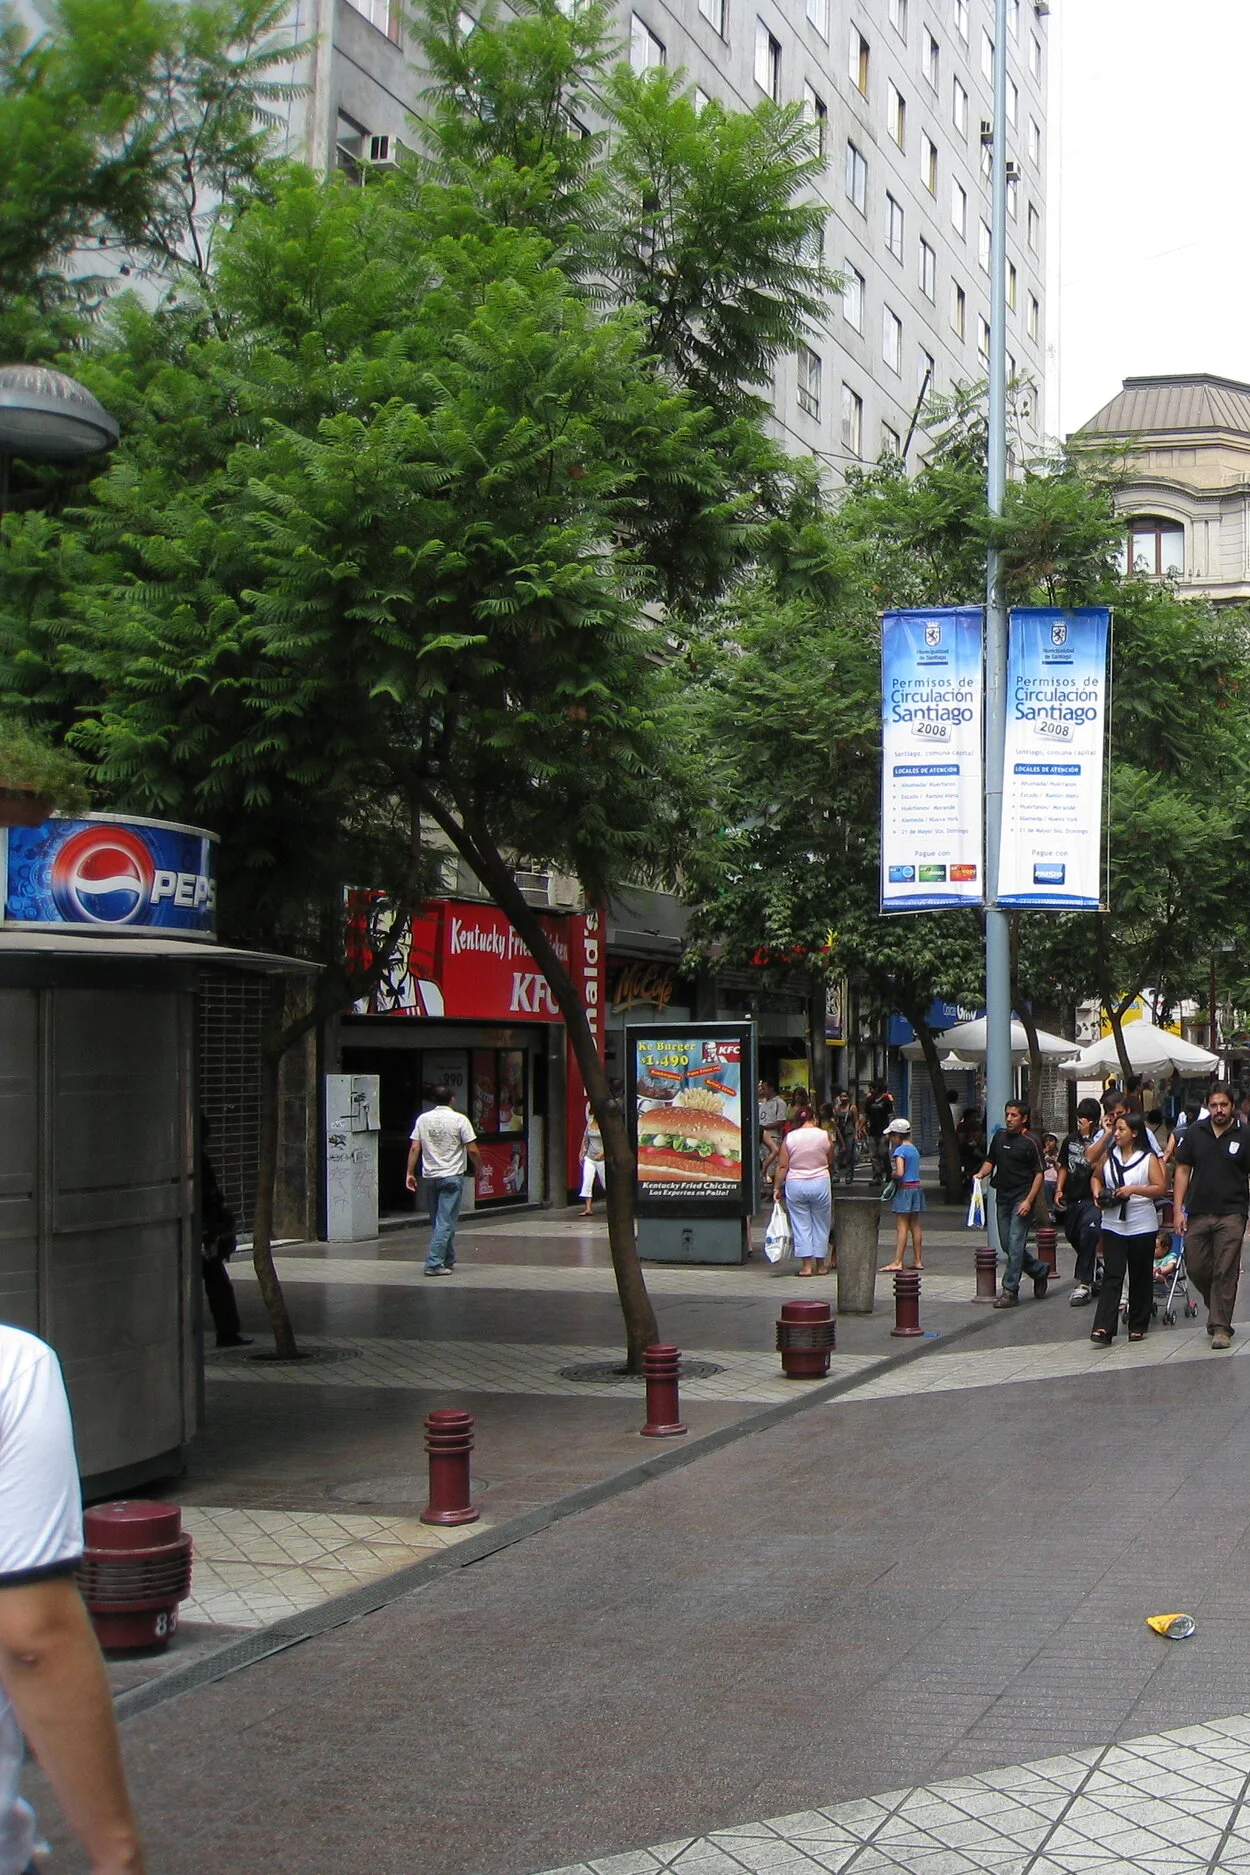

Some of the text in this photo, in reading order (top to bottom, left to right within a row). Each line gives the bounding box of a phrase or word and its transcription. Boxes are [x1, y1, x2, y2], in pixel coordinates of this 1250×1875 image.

[892, 677, 974, 688] Permisos de
[1016, 676, 1099, 687] Permisos de
[891, 688, 973, 704] Circulación
[1015, 687, 1098, 702] Circulación
[892, 704, 973, 726] Santiago
[1015, 702, 1097, 725] Santiago
[917, 722, 947, 737] 2008
[1040, 721, 1069, 736] 2008
[915, 850, 936, 858] Pague
[1031, 849, 1053, 857] Pague
[451, 917, 505, 960] Kentucky
[508, 925, 533, 960] Frie
[509, 972, 559, 1014] KFC
[656, 1042, 696, 1053] Burger
[718, 1046, 741, 1055] KFC
[444, 1073, 463, 1087] 990
[642, 1181, 738, 1191] Kentucky Fried Chicken
